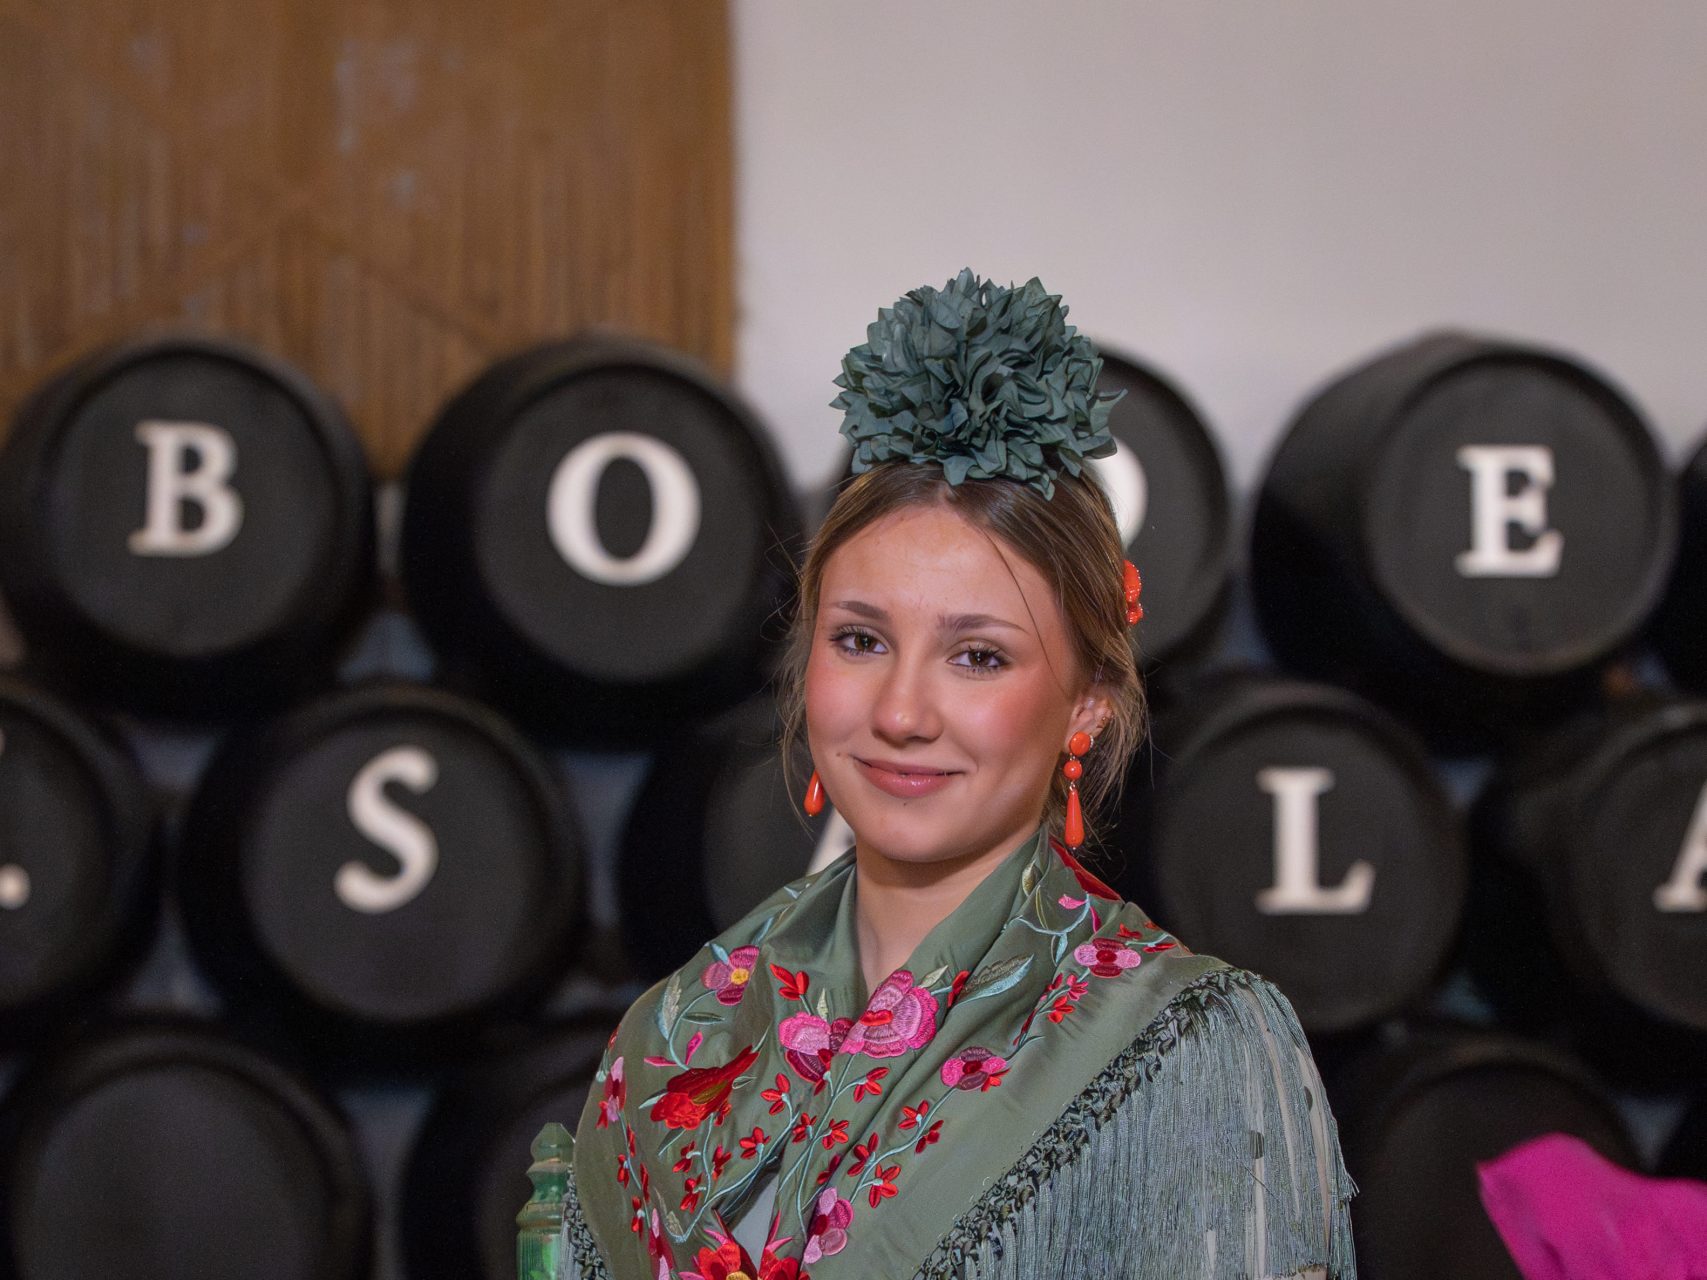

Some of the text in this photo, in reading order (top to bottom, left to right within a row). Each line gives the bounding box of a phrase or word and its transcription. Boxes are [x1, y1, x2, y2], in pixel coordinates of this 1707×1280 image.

[129, 420, 243, 555] B
[547, 431, 701, 586] O
[1455, 443, 1564, 577] E
[334, 745, 438, 912] S
[1256, 766, 1376, 914] L
